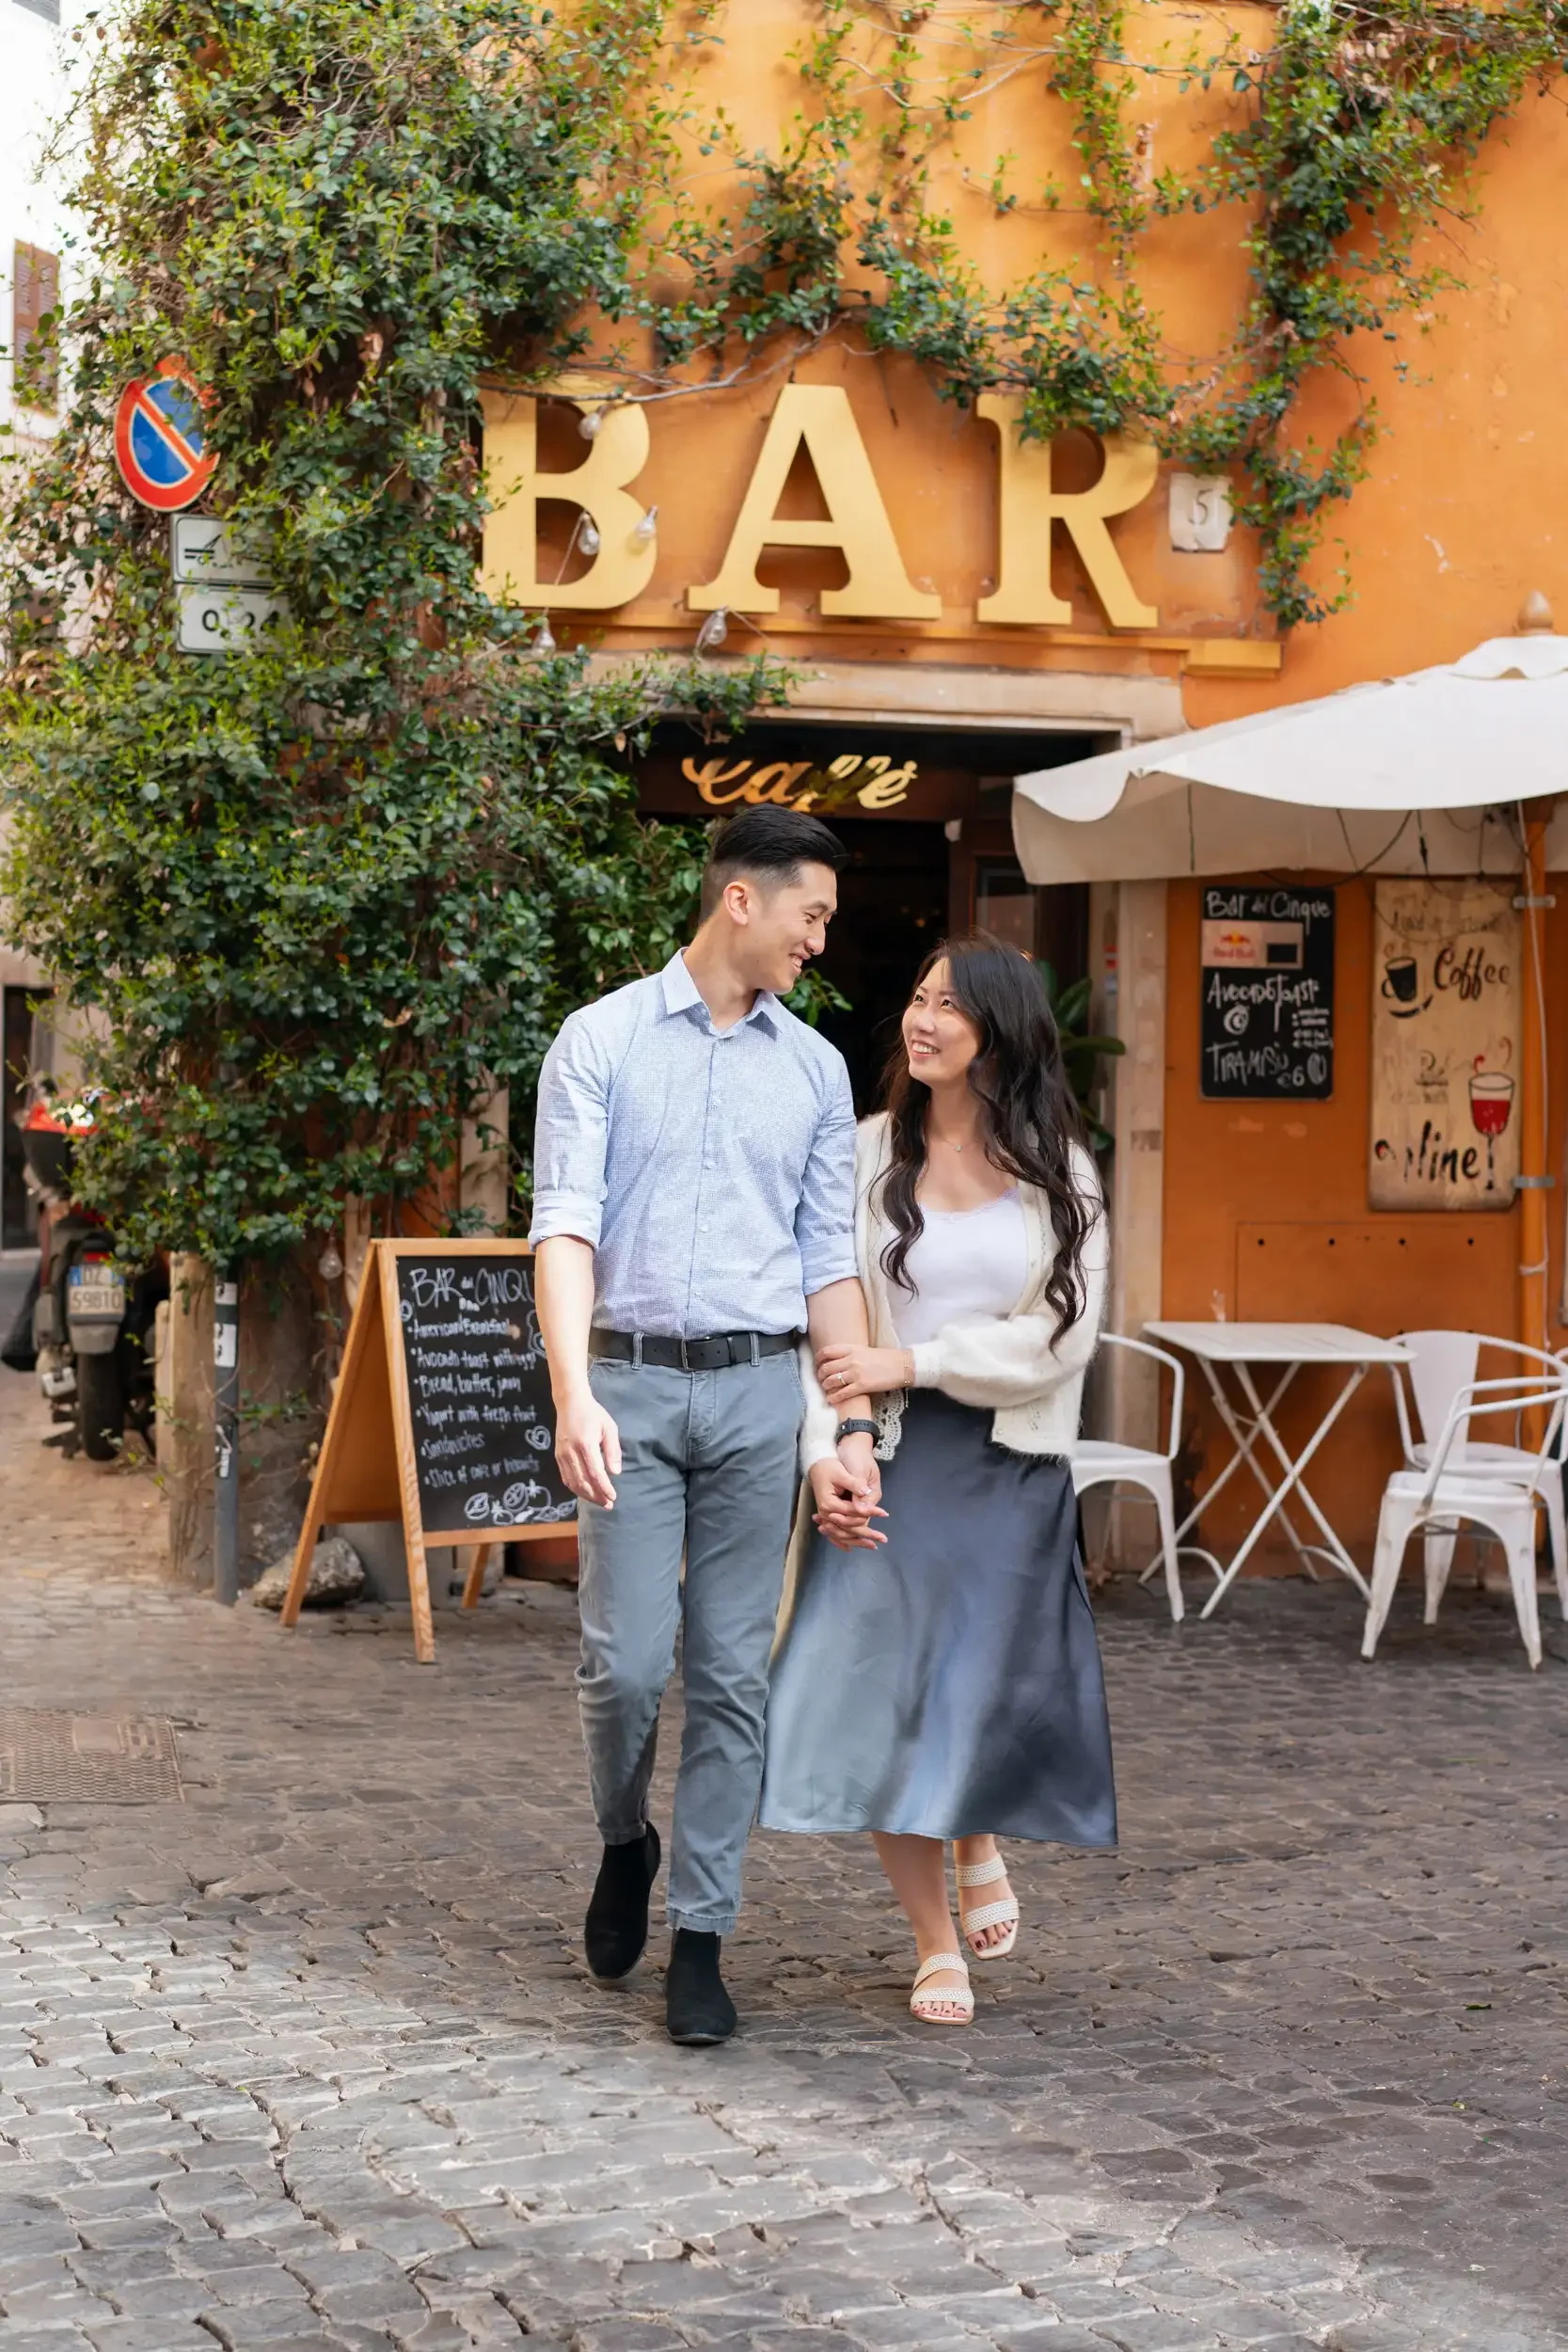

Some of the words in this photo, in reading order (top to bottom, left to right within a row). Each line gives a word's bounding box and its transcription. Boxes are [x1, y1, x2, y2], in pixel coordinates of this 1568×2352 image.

[476, 373, 1160, 629] BAR
[1188, 487, 1213, 526] 5
[1270, 890, 1332, 936] Cinque
[1433, 945, 1511, 1001] Coffee
[408, 1267, 463, 1309] BAR
[474, 1267, 535, 1307] CINQU
